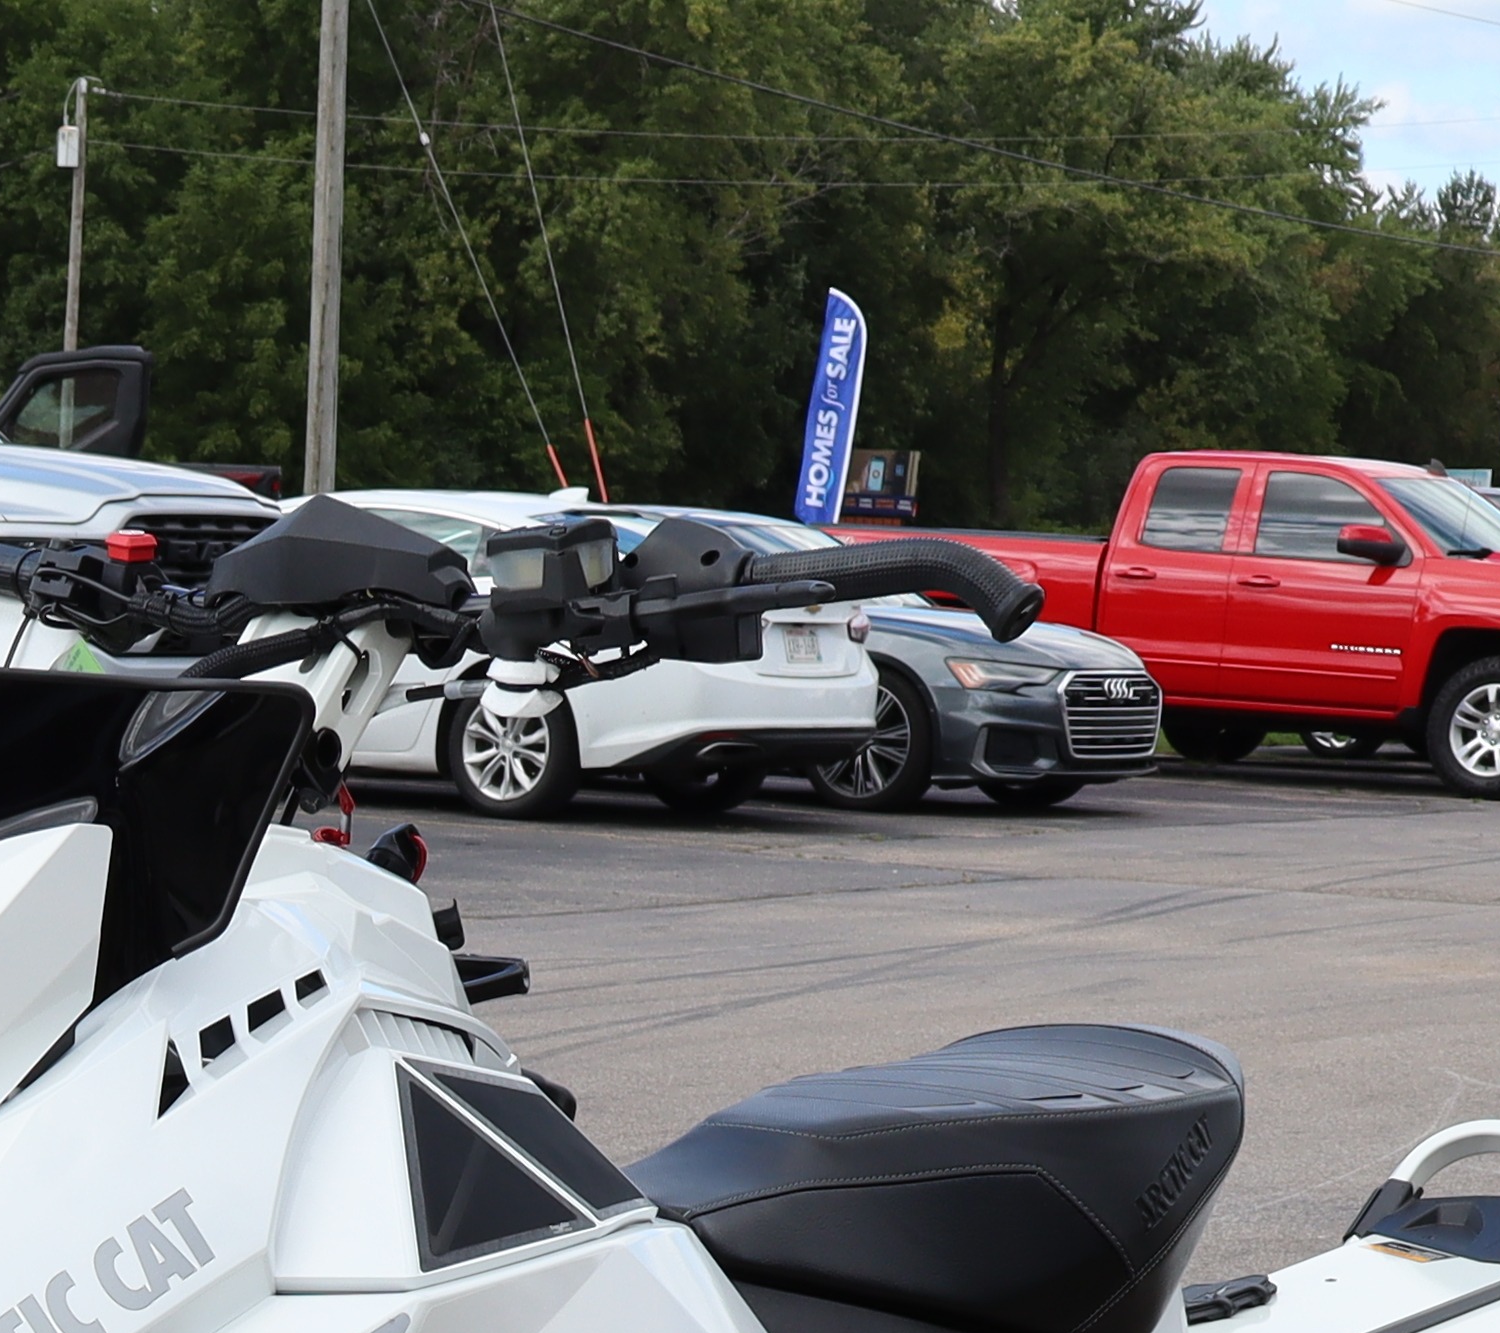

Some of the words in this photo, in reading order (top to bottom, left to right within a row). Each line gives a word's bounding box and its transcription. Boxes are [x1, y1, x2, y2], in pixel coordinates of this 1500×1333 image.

[826, 317, 857, 381] SALE
[820, 379, 846, 411] for
[805, 409, 839, 508] HOMES
[1133, 1143, 1194, 1234] ARCTIC
[91, 1187, 218, 1312] CAT
